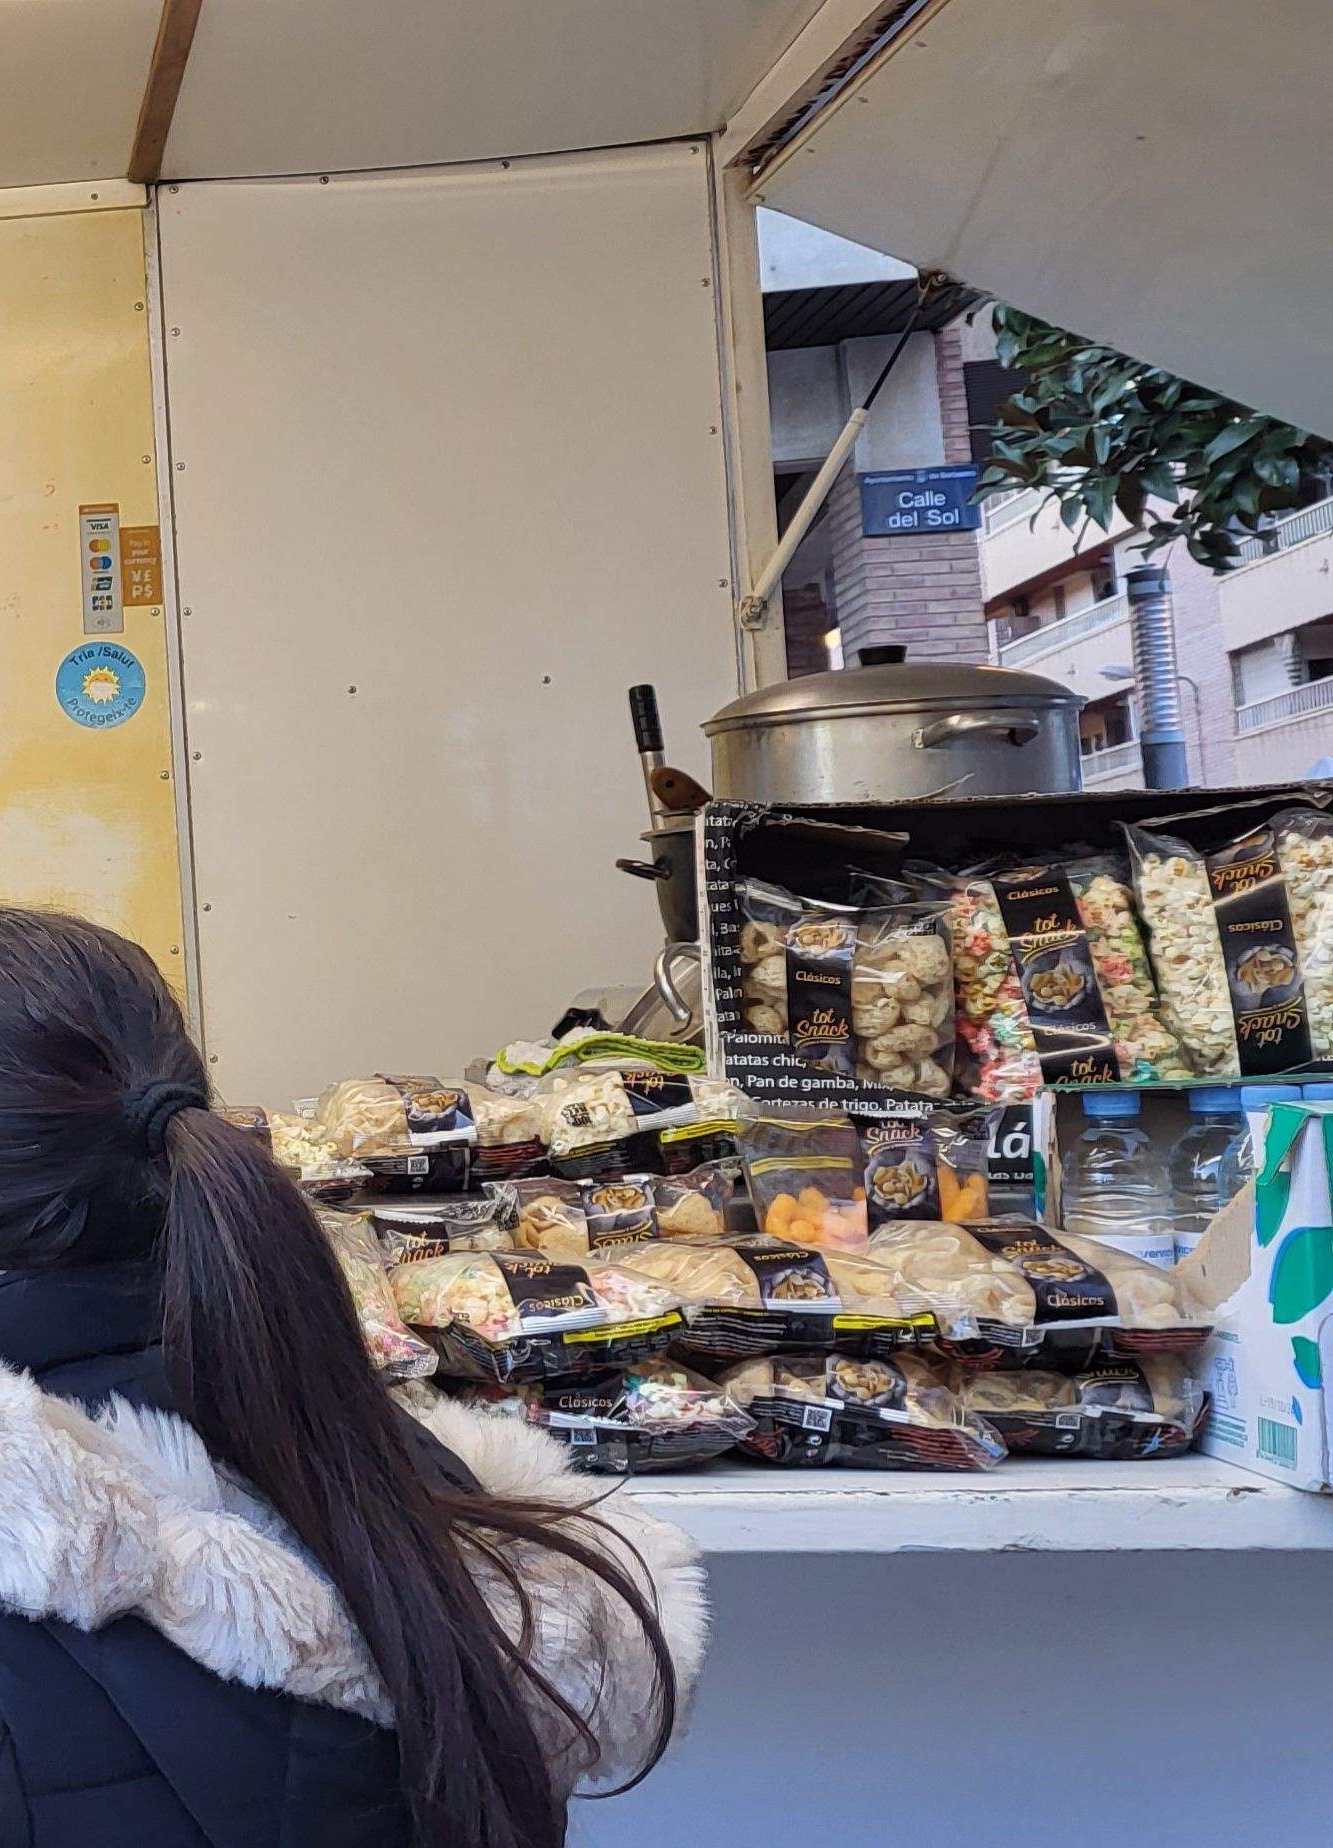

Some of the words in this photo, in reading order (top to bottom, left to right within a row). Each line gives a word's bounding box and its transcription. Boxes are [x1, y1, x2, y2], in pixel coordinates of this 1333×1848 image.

[898, 490, 946, 508] Calle
[888, 510, 918, 528] del
[927, 508, 960, 526] Sol
[69, 648, 95, 668] Tria
[1006, 886, 1060, 901] Clásicos
[1033, 912, 1061, 933] tot
[1227, 919, 1283, 933] Clásicos
[795, 970, 842, 985] Clásicos
[813, 1008, 836, 1024] tot
[793, 1017, 850, 1039] Snack
[1071, 1055, 1097, 1077] tot
[747, 1074, 774, 1088] Pan
[778, 1074, 798, 1088] de
[801, 1075, 859, 1091] gamba,
[818, 1098, 839, 1109] de
[865, 1123, 924, 1144] Snack
[398, 1238, 446, 1265] nack
[528, 1294, 584, 1312] Clásicos
[558, 1392, 613, 1409] Clásicos
